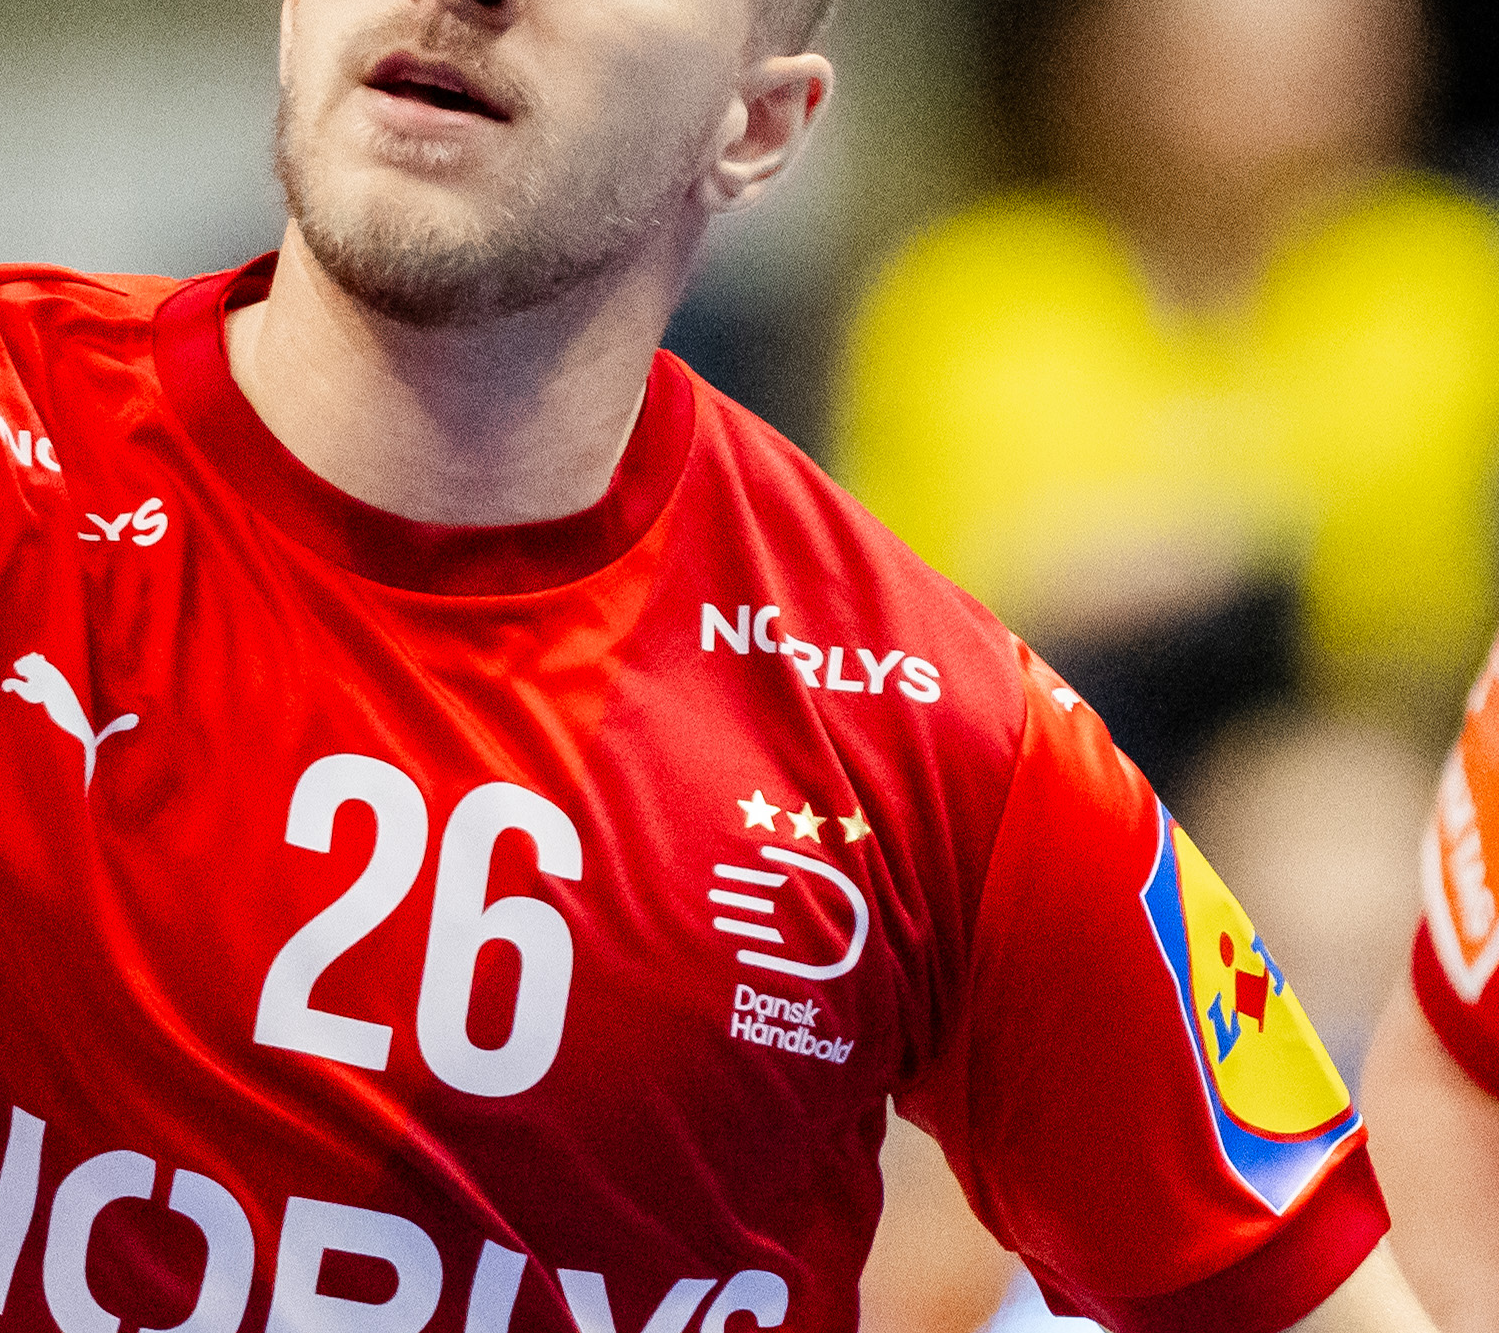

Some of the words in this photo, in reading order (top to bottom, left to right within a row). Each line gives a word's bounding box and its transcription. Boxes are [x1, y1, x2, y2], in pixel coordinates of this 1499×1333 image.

[701, 603, 942, 704] NORLYS
[253, 753, 583, 1099] 26
[730, 1011, 855, 1065] Håndbold
[733, 983, 821, 1028] Dansk
